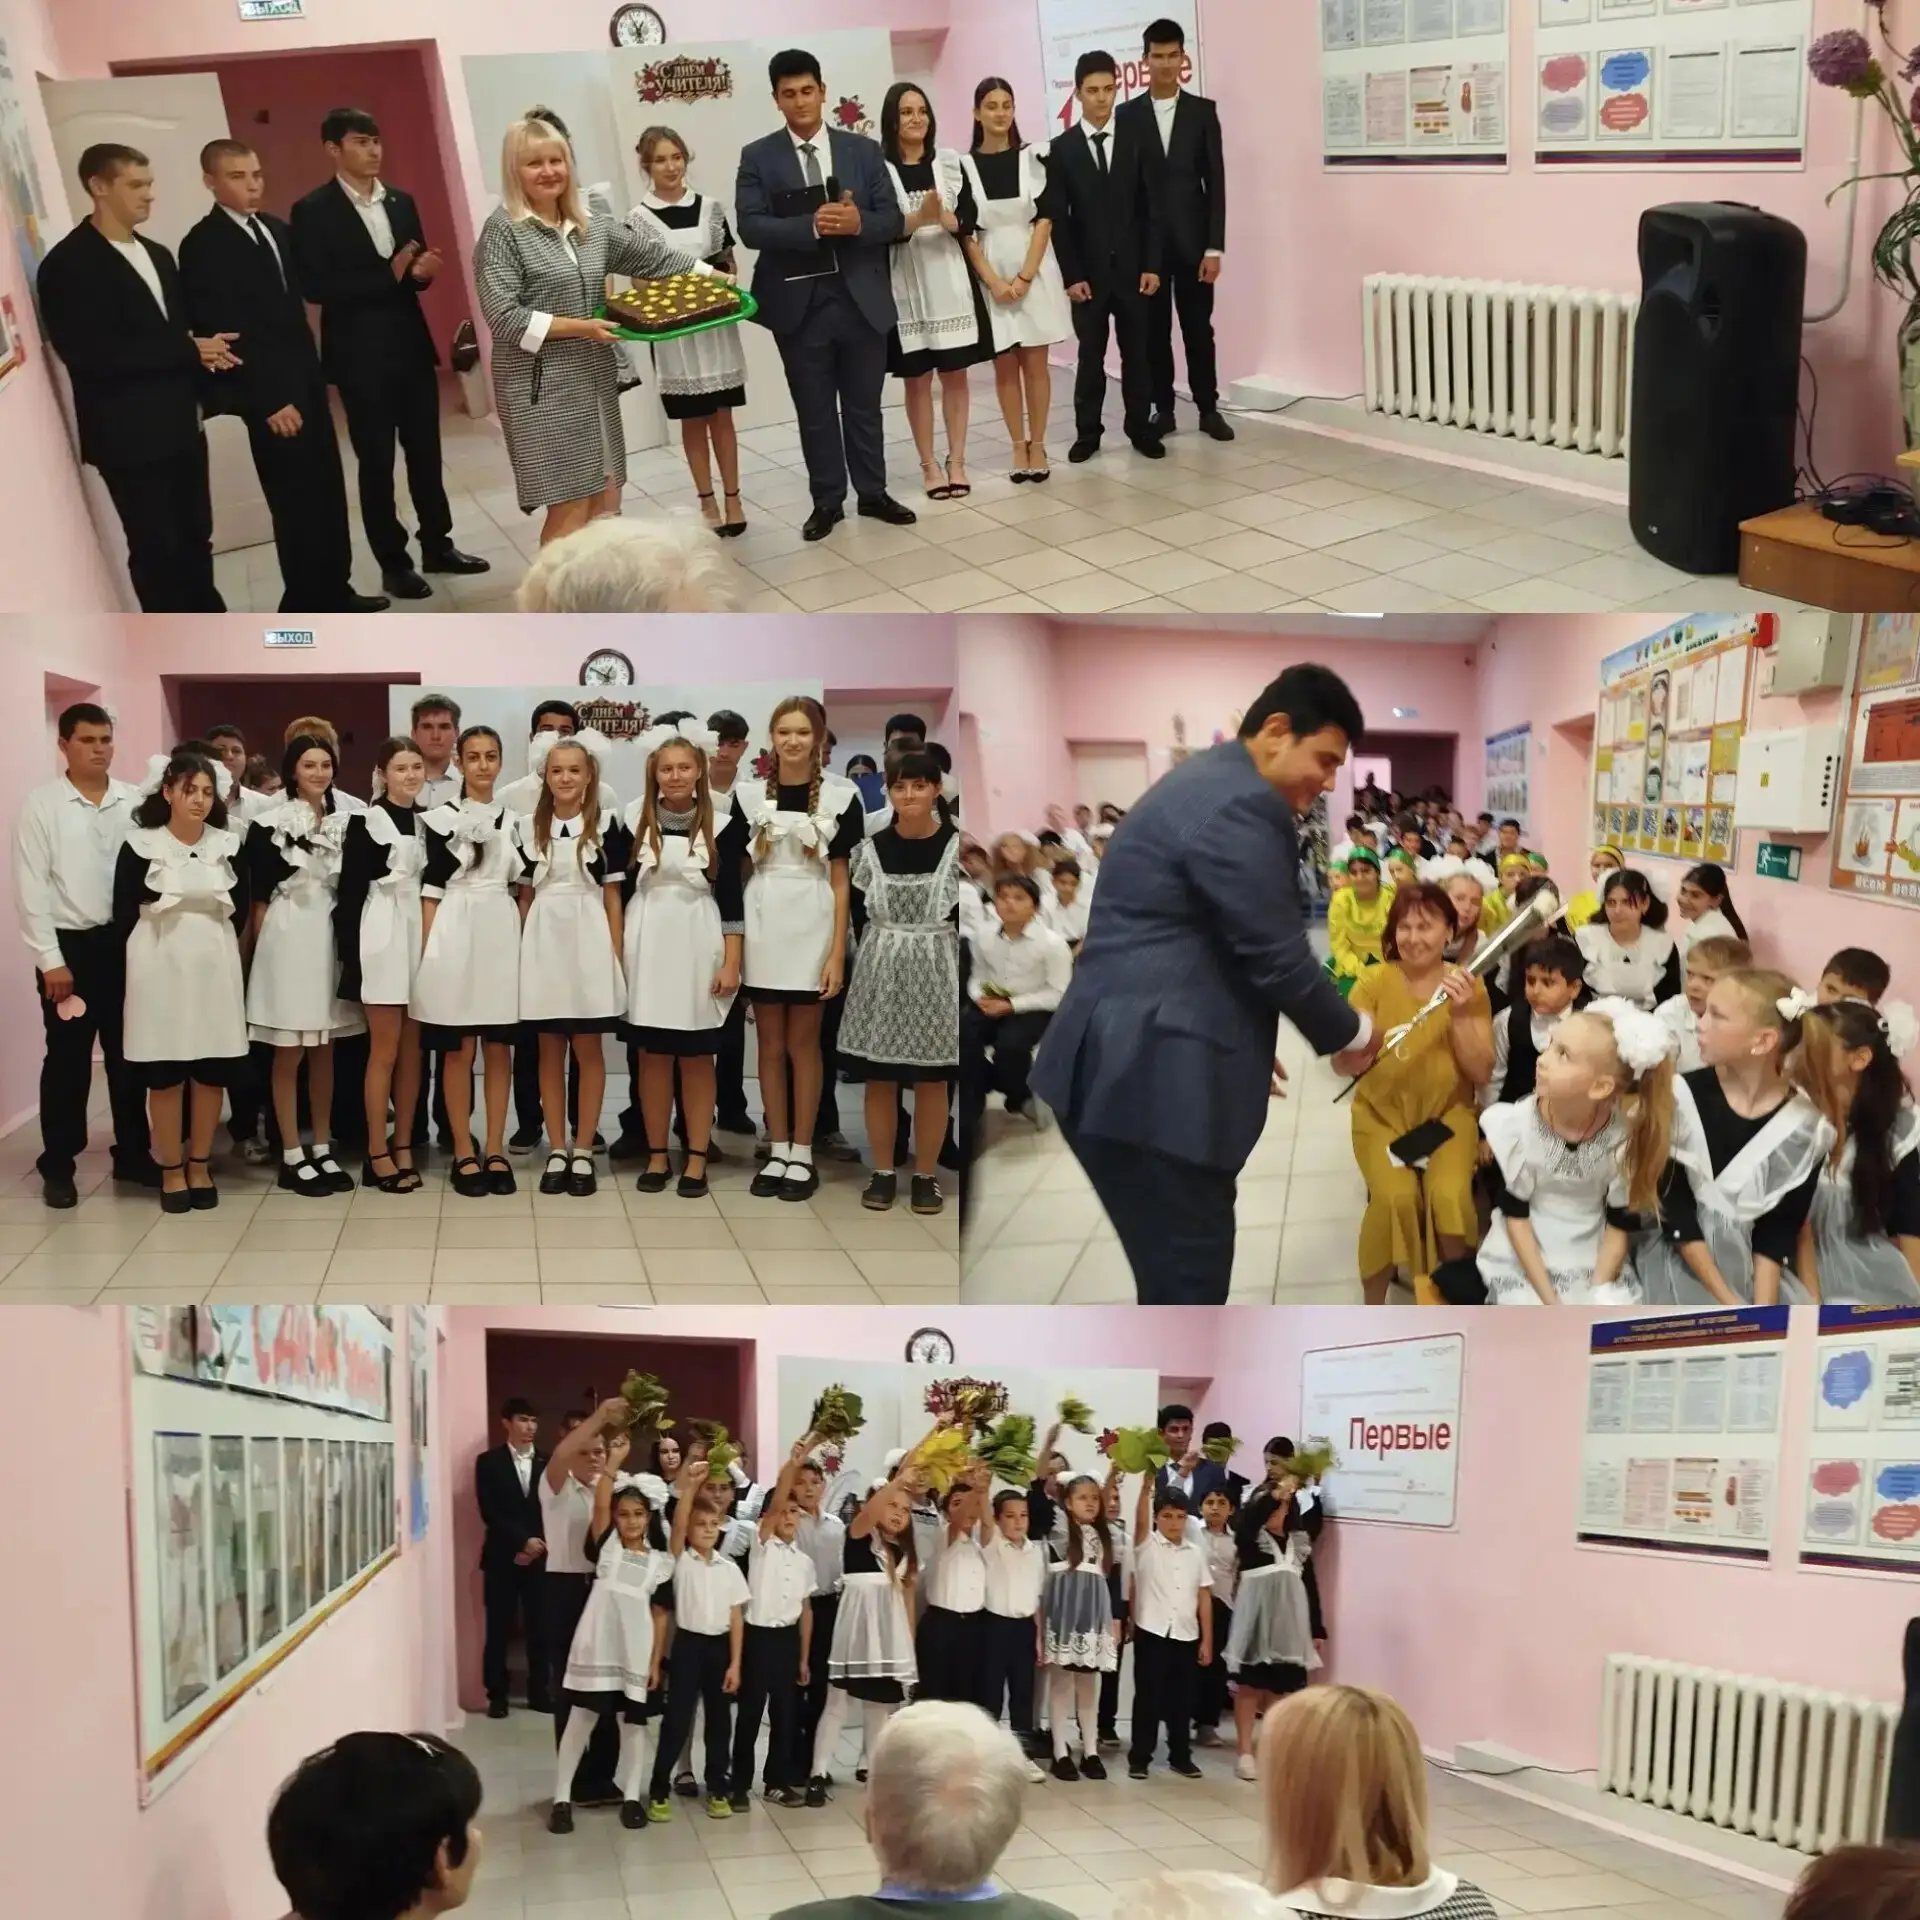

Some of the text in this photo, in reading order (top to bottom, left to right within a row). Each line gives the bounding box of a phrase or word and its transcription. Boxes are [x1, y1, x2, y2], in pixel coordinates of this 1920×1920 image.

[655, 75, 727, 96] УЧИТЕЛЯ!
[1114, 53, 1192, 101] ерве
[269, 632, 312, 644] ВЫХОД
[1349, 1416, 1451, 1461] Первые
